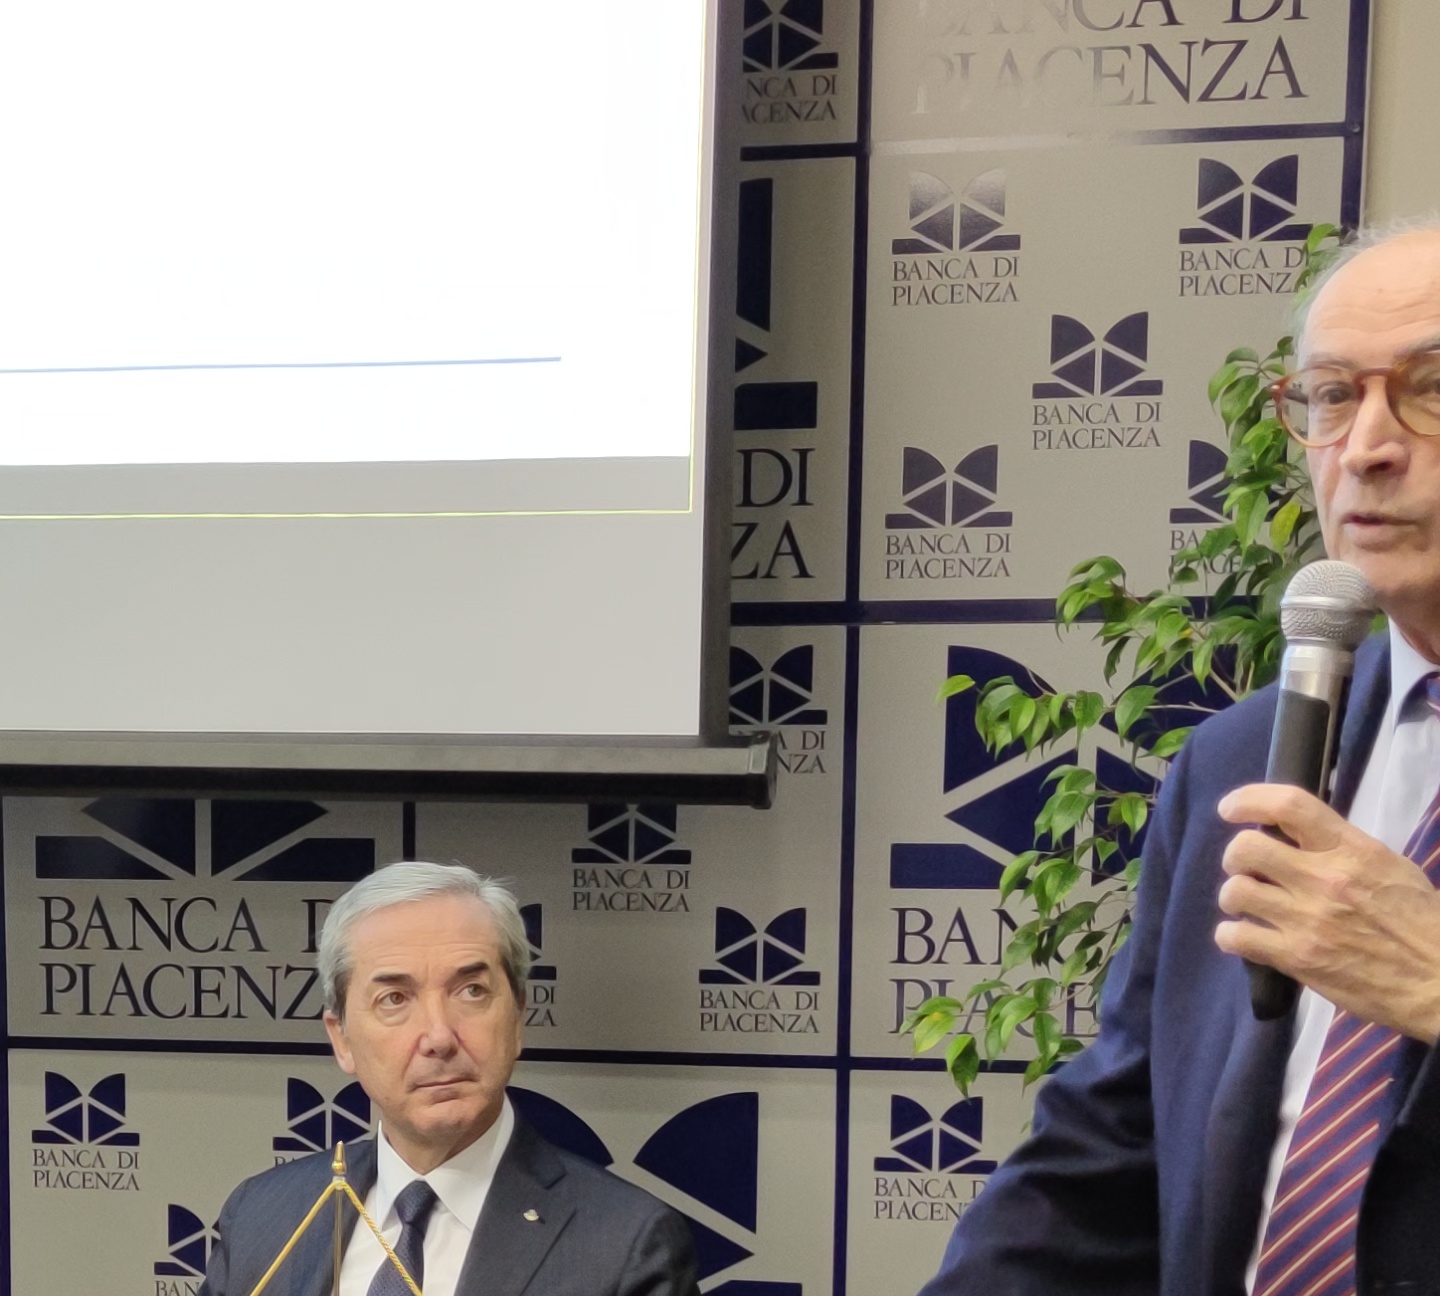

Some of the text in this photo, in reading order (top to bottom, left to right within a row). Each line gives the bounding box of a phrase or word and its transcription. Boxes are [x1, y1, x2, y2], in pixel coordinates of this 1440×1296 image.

[746, 74, 838, 99] NCA DI
[741, 99, 837, 124] CENZA
[892, 256, 1020, 281] BANCA DI
[1179, 248, 1270, 271] BANCA
[891, 281, 1019, 306] PIACENZA
[1032, 401, 1162, 426] BANCA DI
[1032, 426, 1162, 451] PIACENZA
[737, 447, 816, 508] DI
[885, 531, 1012, 556] BANCA DI
[884, 555, 1011, 580] PIACENZA
[802, 730, 826, 750] DI
[573, 868, 691, 890] BANCA DI
[572, 892, 690, 913] PIACENZA
[39, 896, 270, 953] BANCA
[39, 963, 322, 1021] PIACENZ
[532, 985, 556, 1005] DI
[699, 990, 819, 1011] BANCA DI
[699, 1012, 820, 1034] PIACENZA
[32, 1149, 140, 1172] BANCA DI
[32, 1169, 141, 1192] PIACENZA
[874, 1177, 957, 1199] BANCA
[874, 1201, 970, 1221] PIACEN
